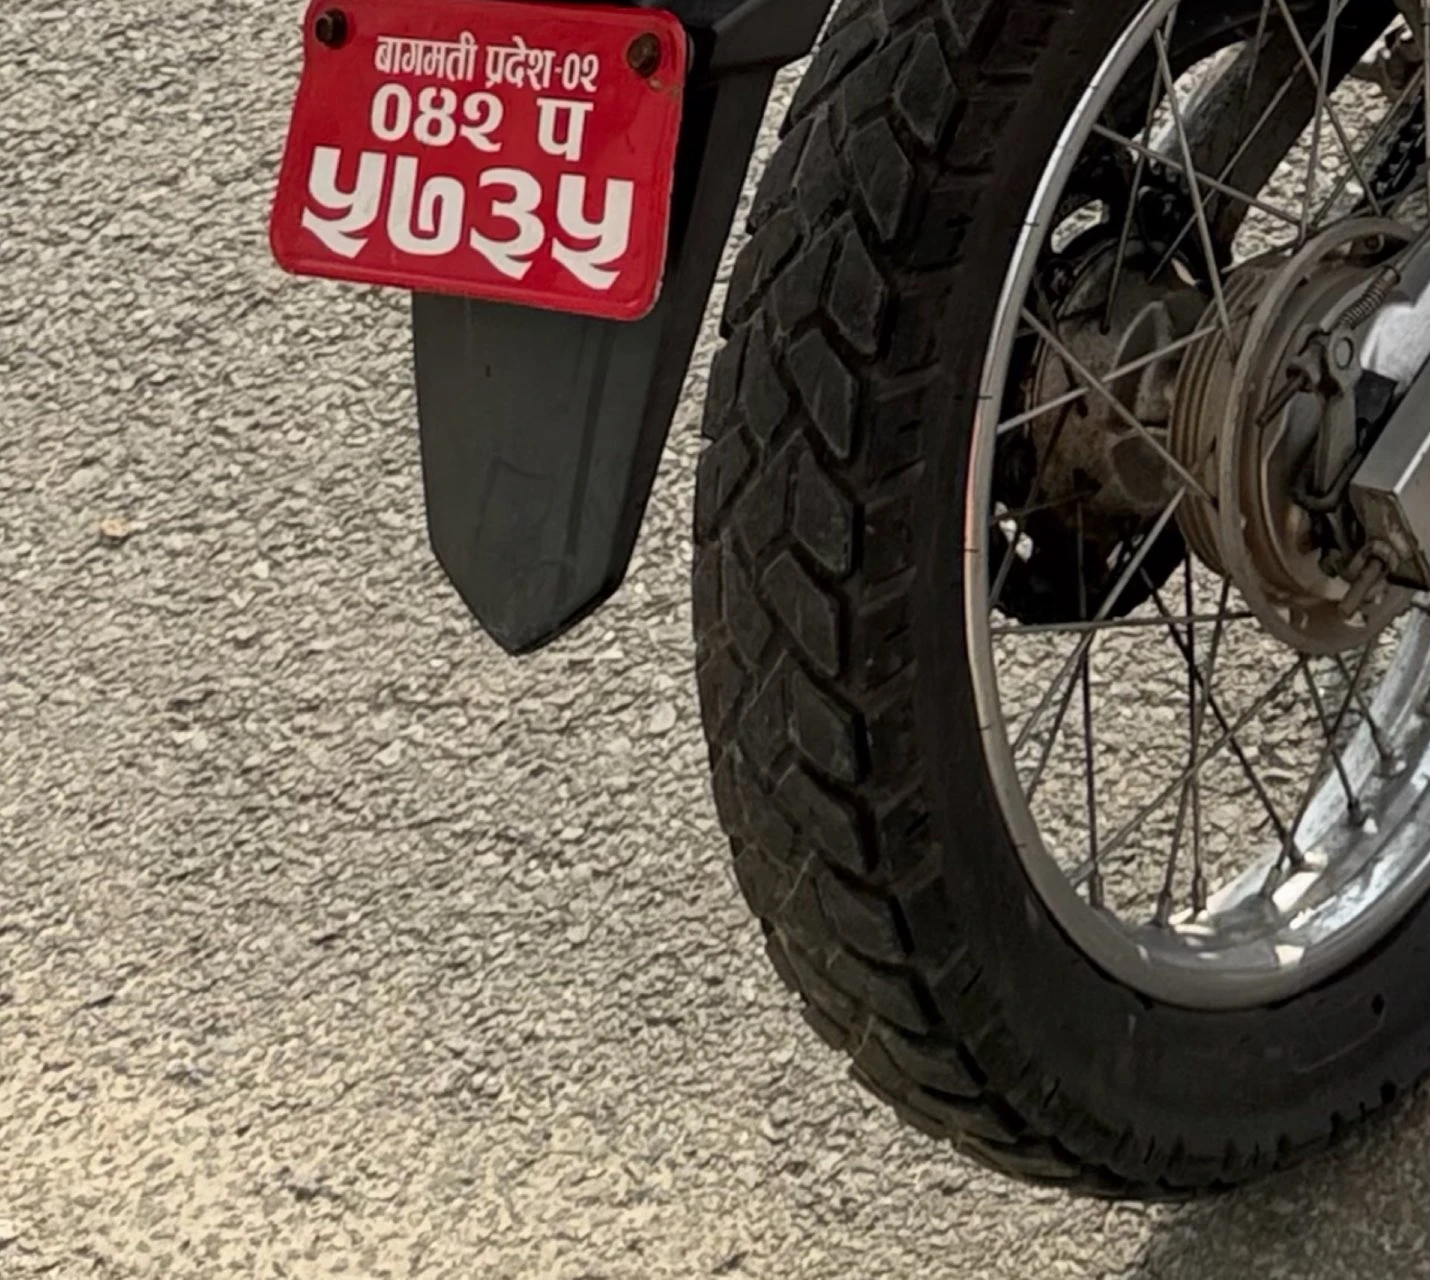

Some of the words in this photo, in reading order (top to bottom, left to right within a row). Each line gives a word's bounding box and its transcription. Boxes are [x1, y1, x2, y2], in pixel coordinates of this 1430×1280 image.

[374, 30, 478, 82] बागमती
[371, 83, 504, 153] ०४२
[536, 97, 594, 162] प
[301, 145, 635, 291] ५७३५
